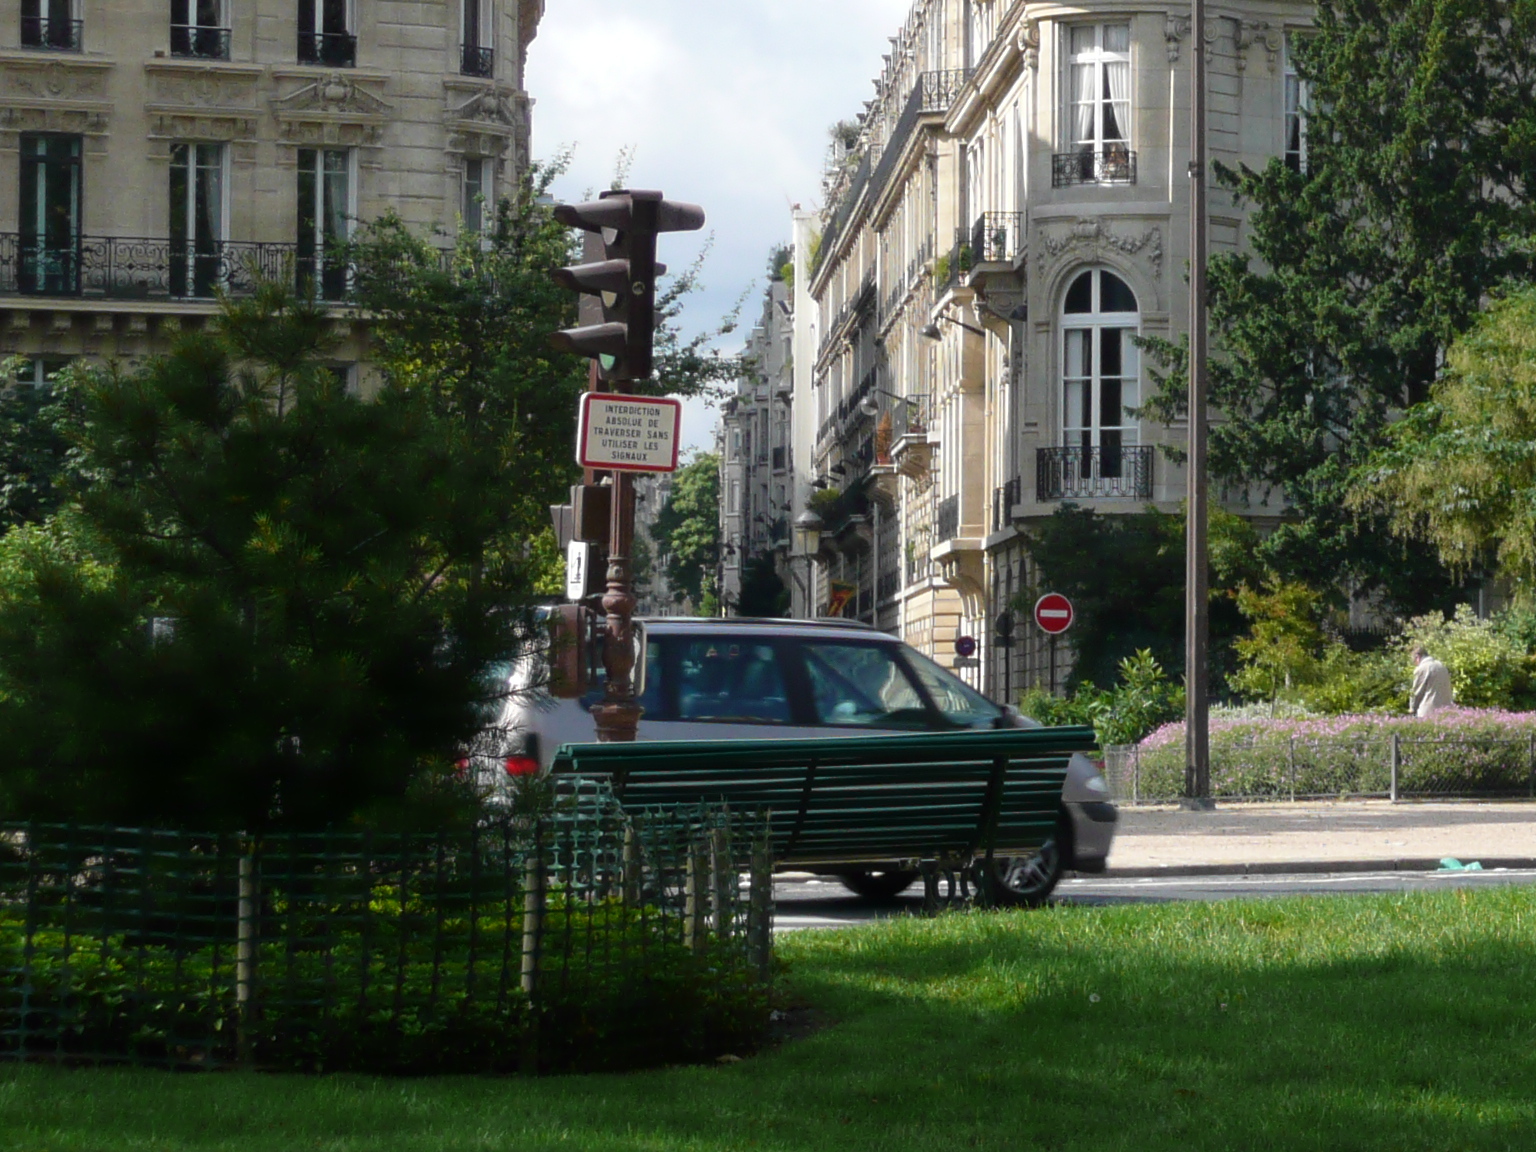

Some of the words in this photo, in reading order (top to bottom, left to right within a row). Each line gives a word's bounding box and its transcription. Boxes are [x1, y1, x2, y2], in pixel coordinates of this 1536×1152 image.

[605, 405, 660, 416] INTERDICTION
[605, 416, 642, 427] ABSOLUE
[648, 419, 659, 427] DE
[594, 427, 641, 438] TRAVERSER
[647, 430, 669, 440] SANS
[602, 439, 638, 449] UTILISER
[644, 442, 658, 451] LES
[611, 451, 648, 461] SIGNAUX
